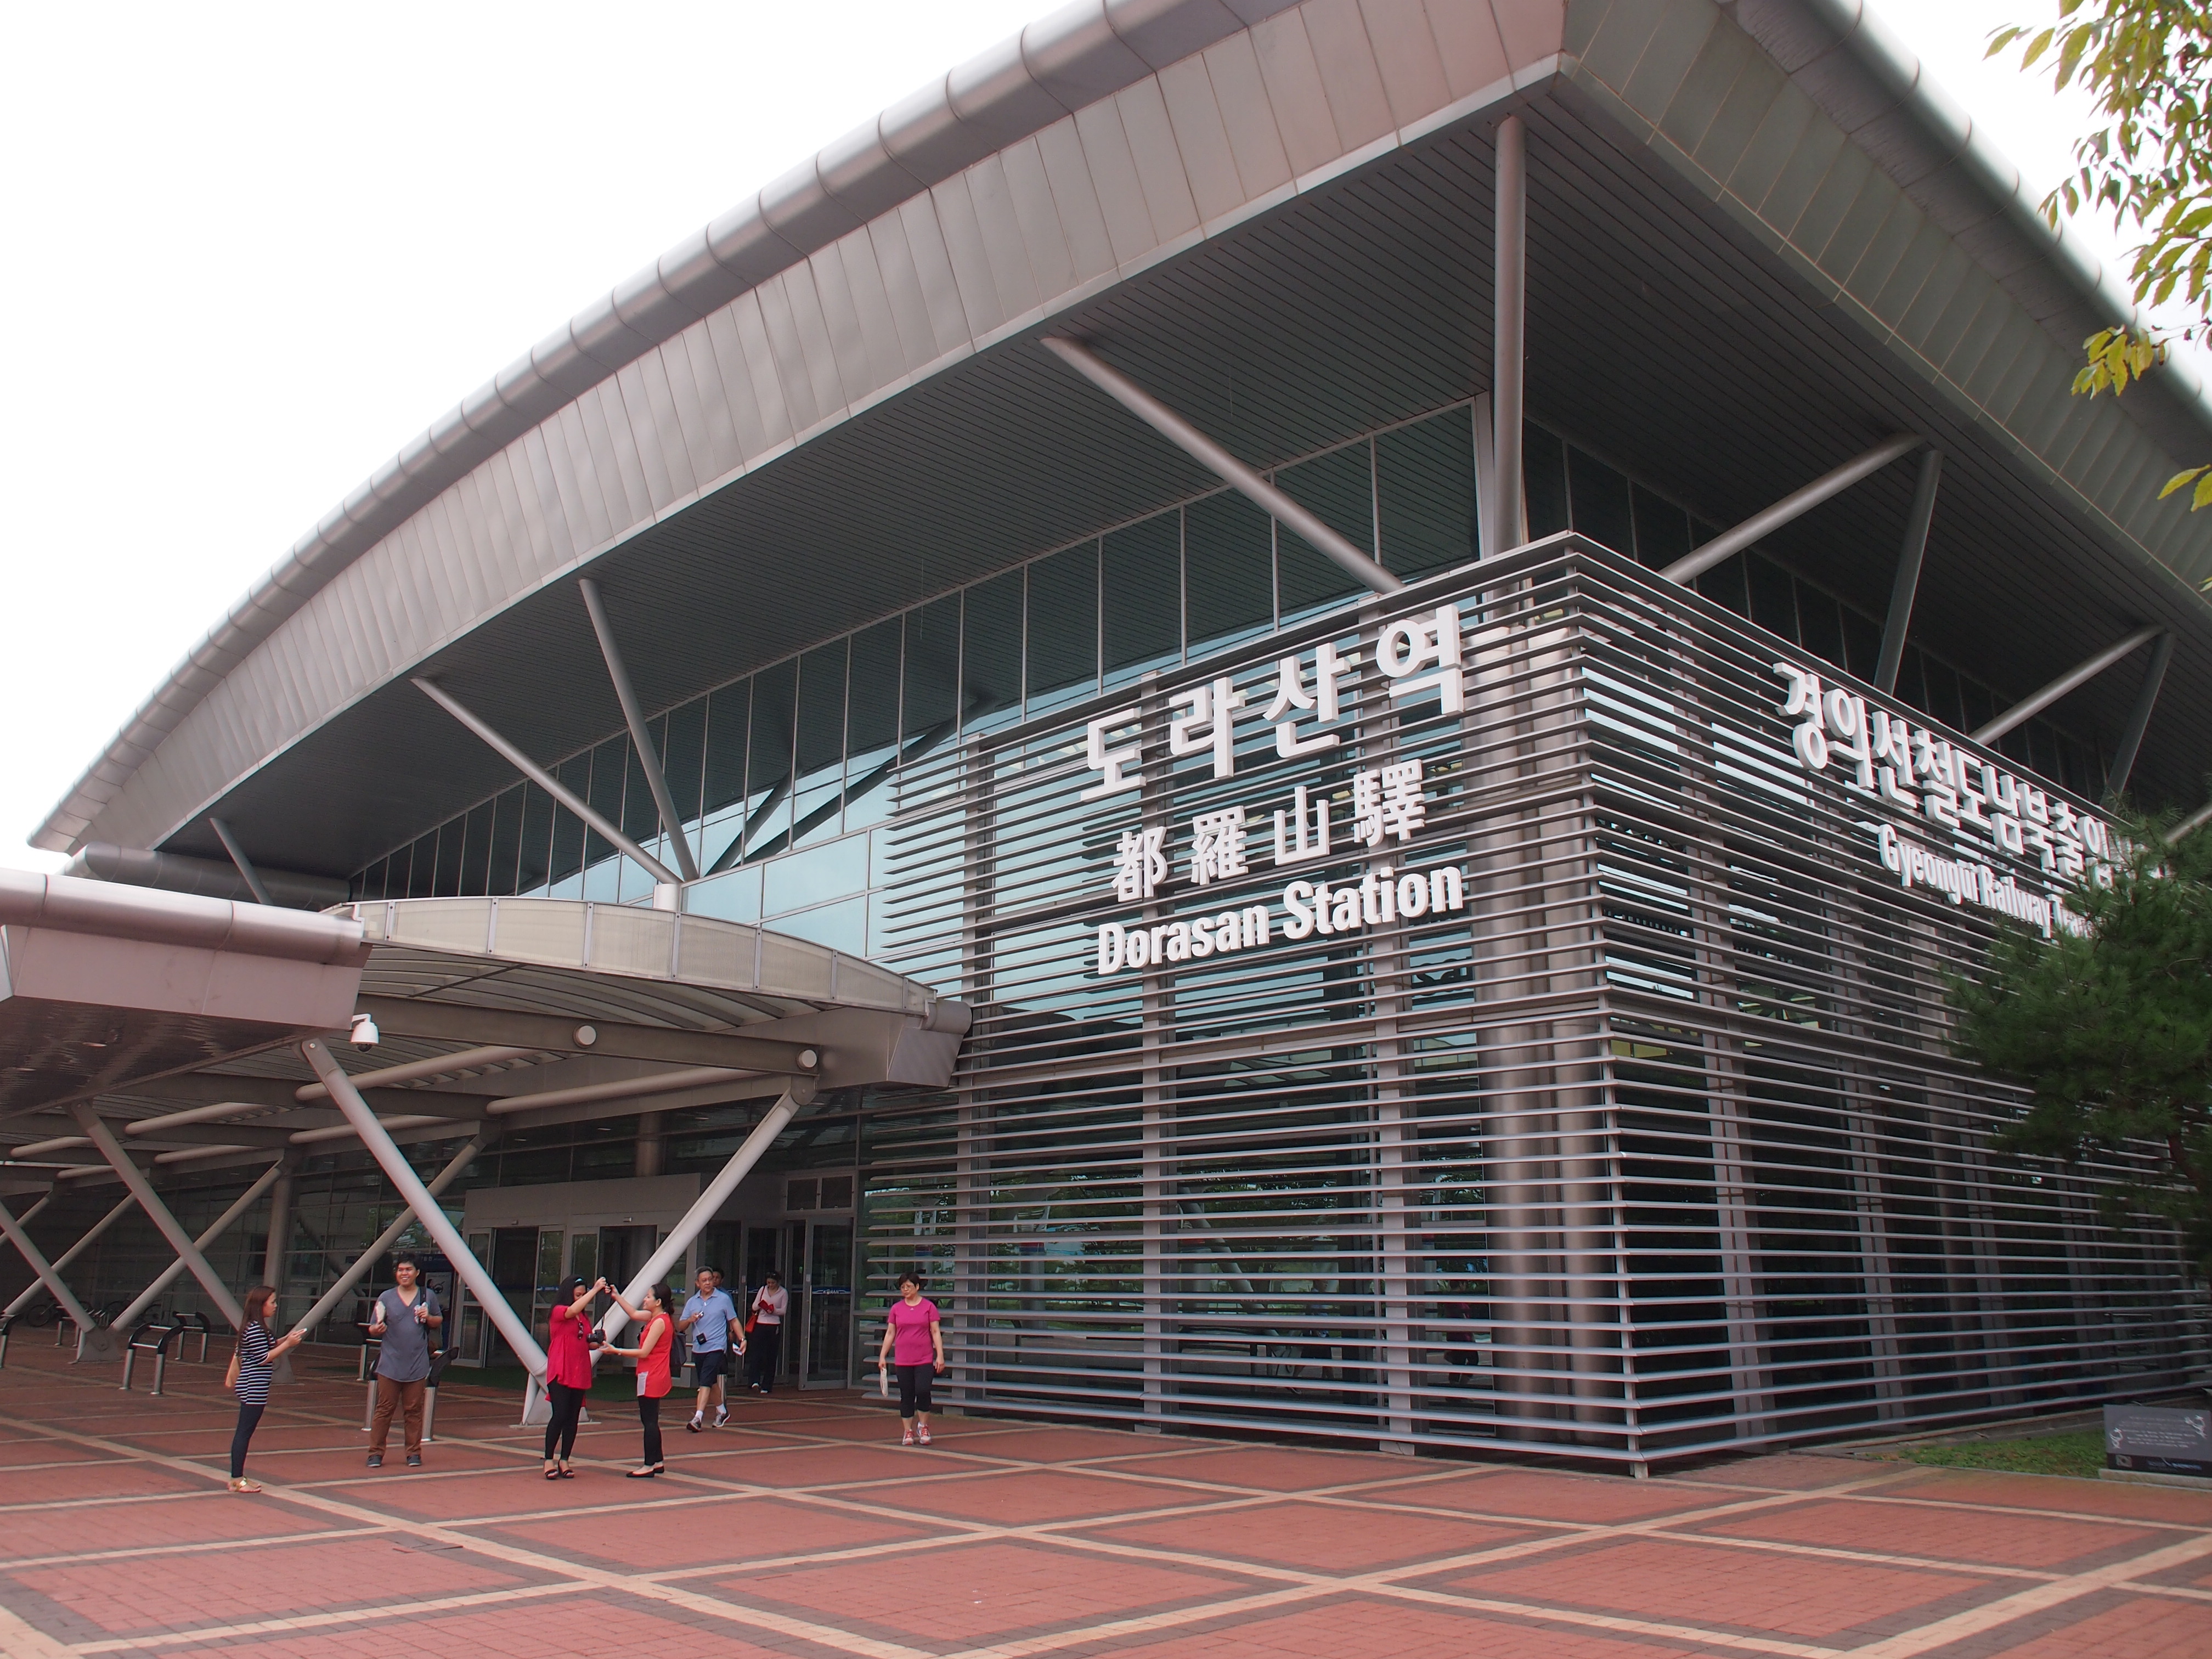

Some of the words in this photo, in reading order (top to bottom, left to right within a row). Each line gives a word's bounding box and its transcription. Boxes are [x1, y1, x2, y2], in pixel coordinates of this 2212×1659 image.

[1081, 604, 1464, 802] 도라산역
[1111, 759, 1425, 902] 都羅山驛
[1878, 823, 1979, 905] Gyeongui
[1978, 865, 2052, 939] Railway
[1098, 905, 1269, 975] Dorasan
[1283, 865, 1463, 940] Station
